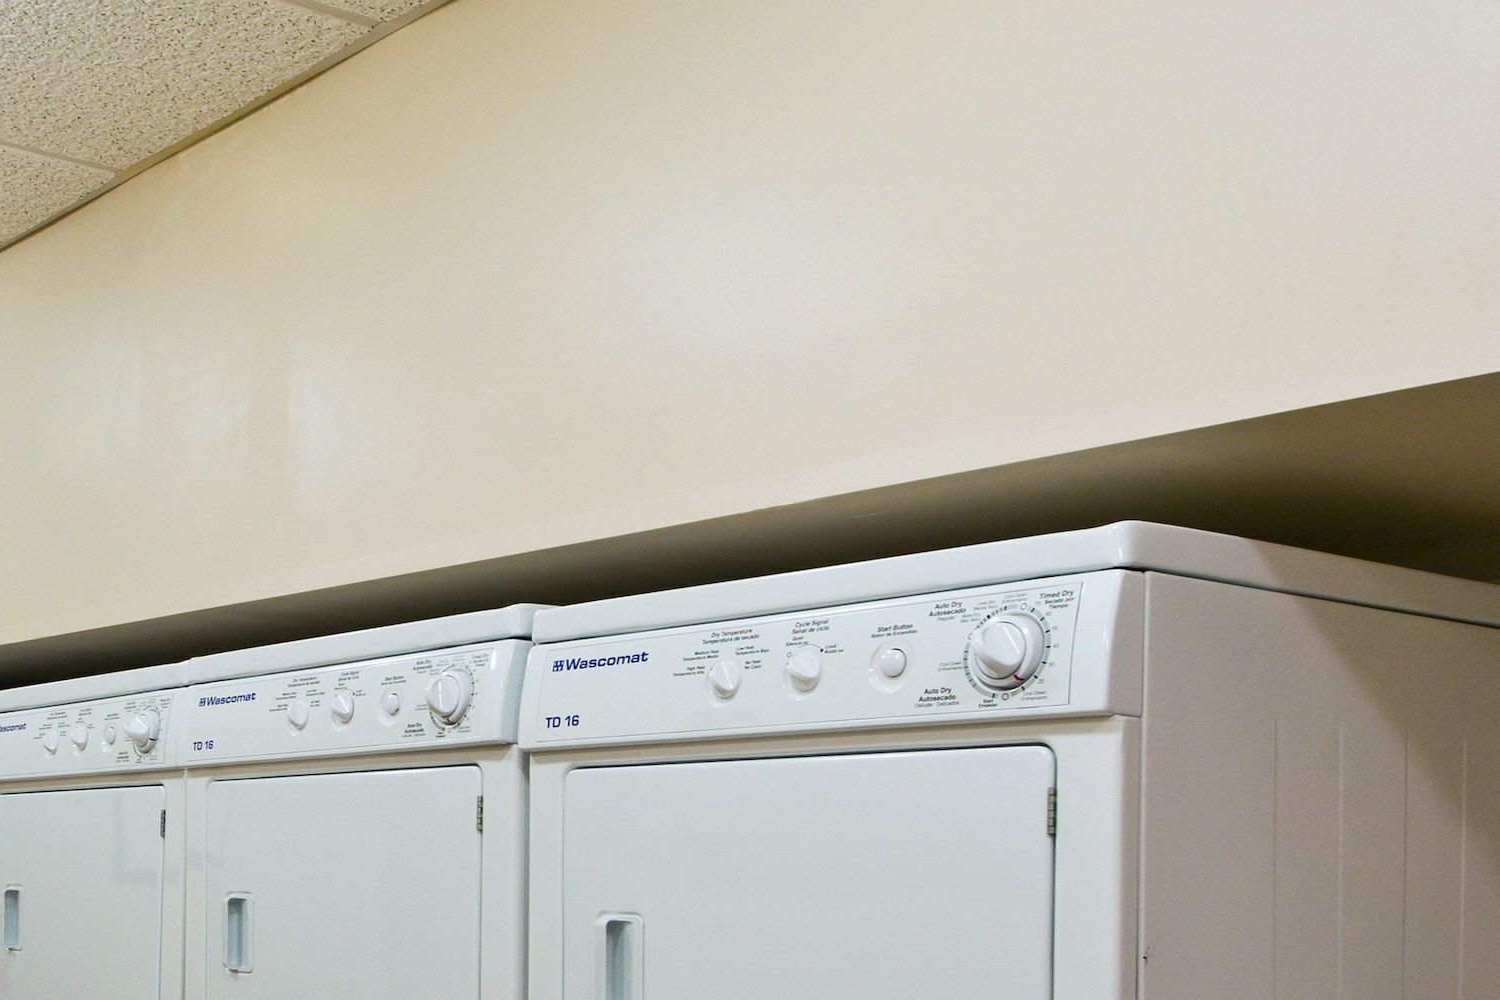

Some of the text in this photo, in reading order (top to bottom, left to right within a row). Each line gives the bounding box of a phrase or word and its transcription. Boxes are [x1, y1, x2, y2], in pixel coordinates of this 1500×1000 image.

[929, 608, 966, 617] Autosecado
[721, 628, 752, 637] Temperature
[565, 651, 648, 671] Wascomat
[207, 692, 256, 706] Wascomat
[546, 714, 579, 729] TD 16
[194, 740, 214, 751] TD 16
